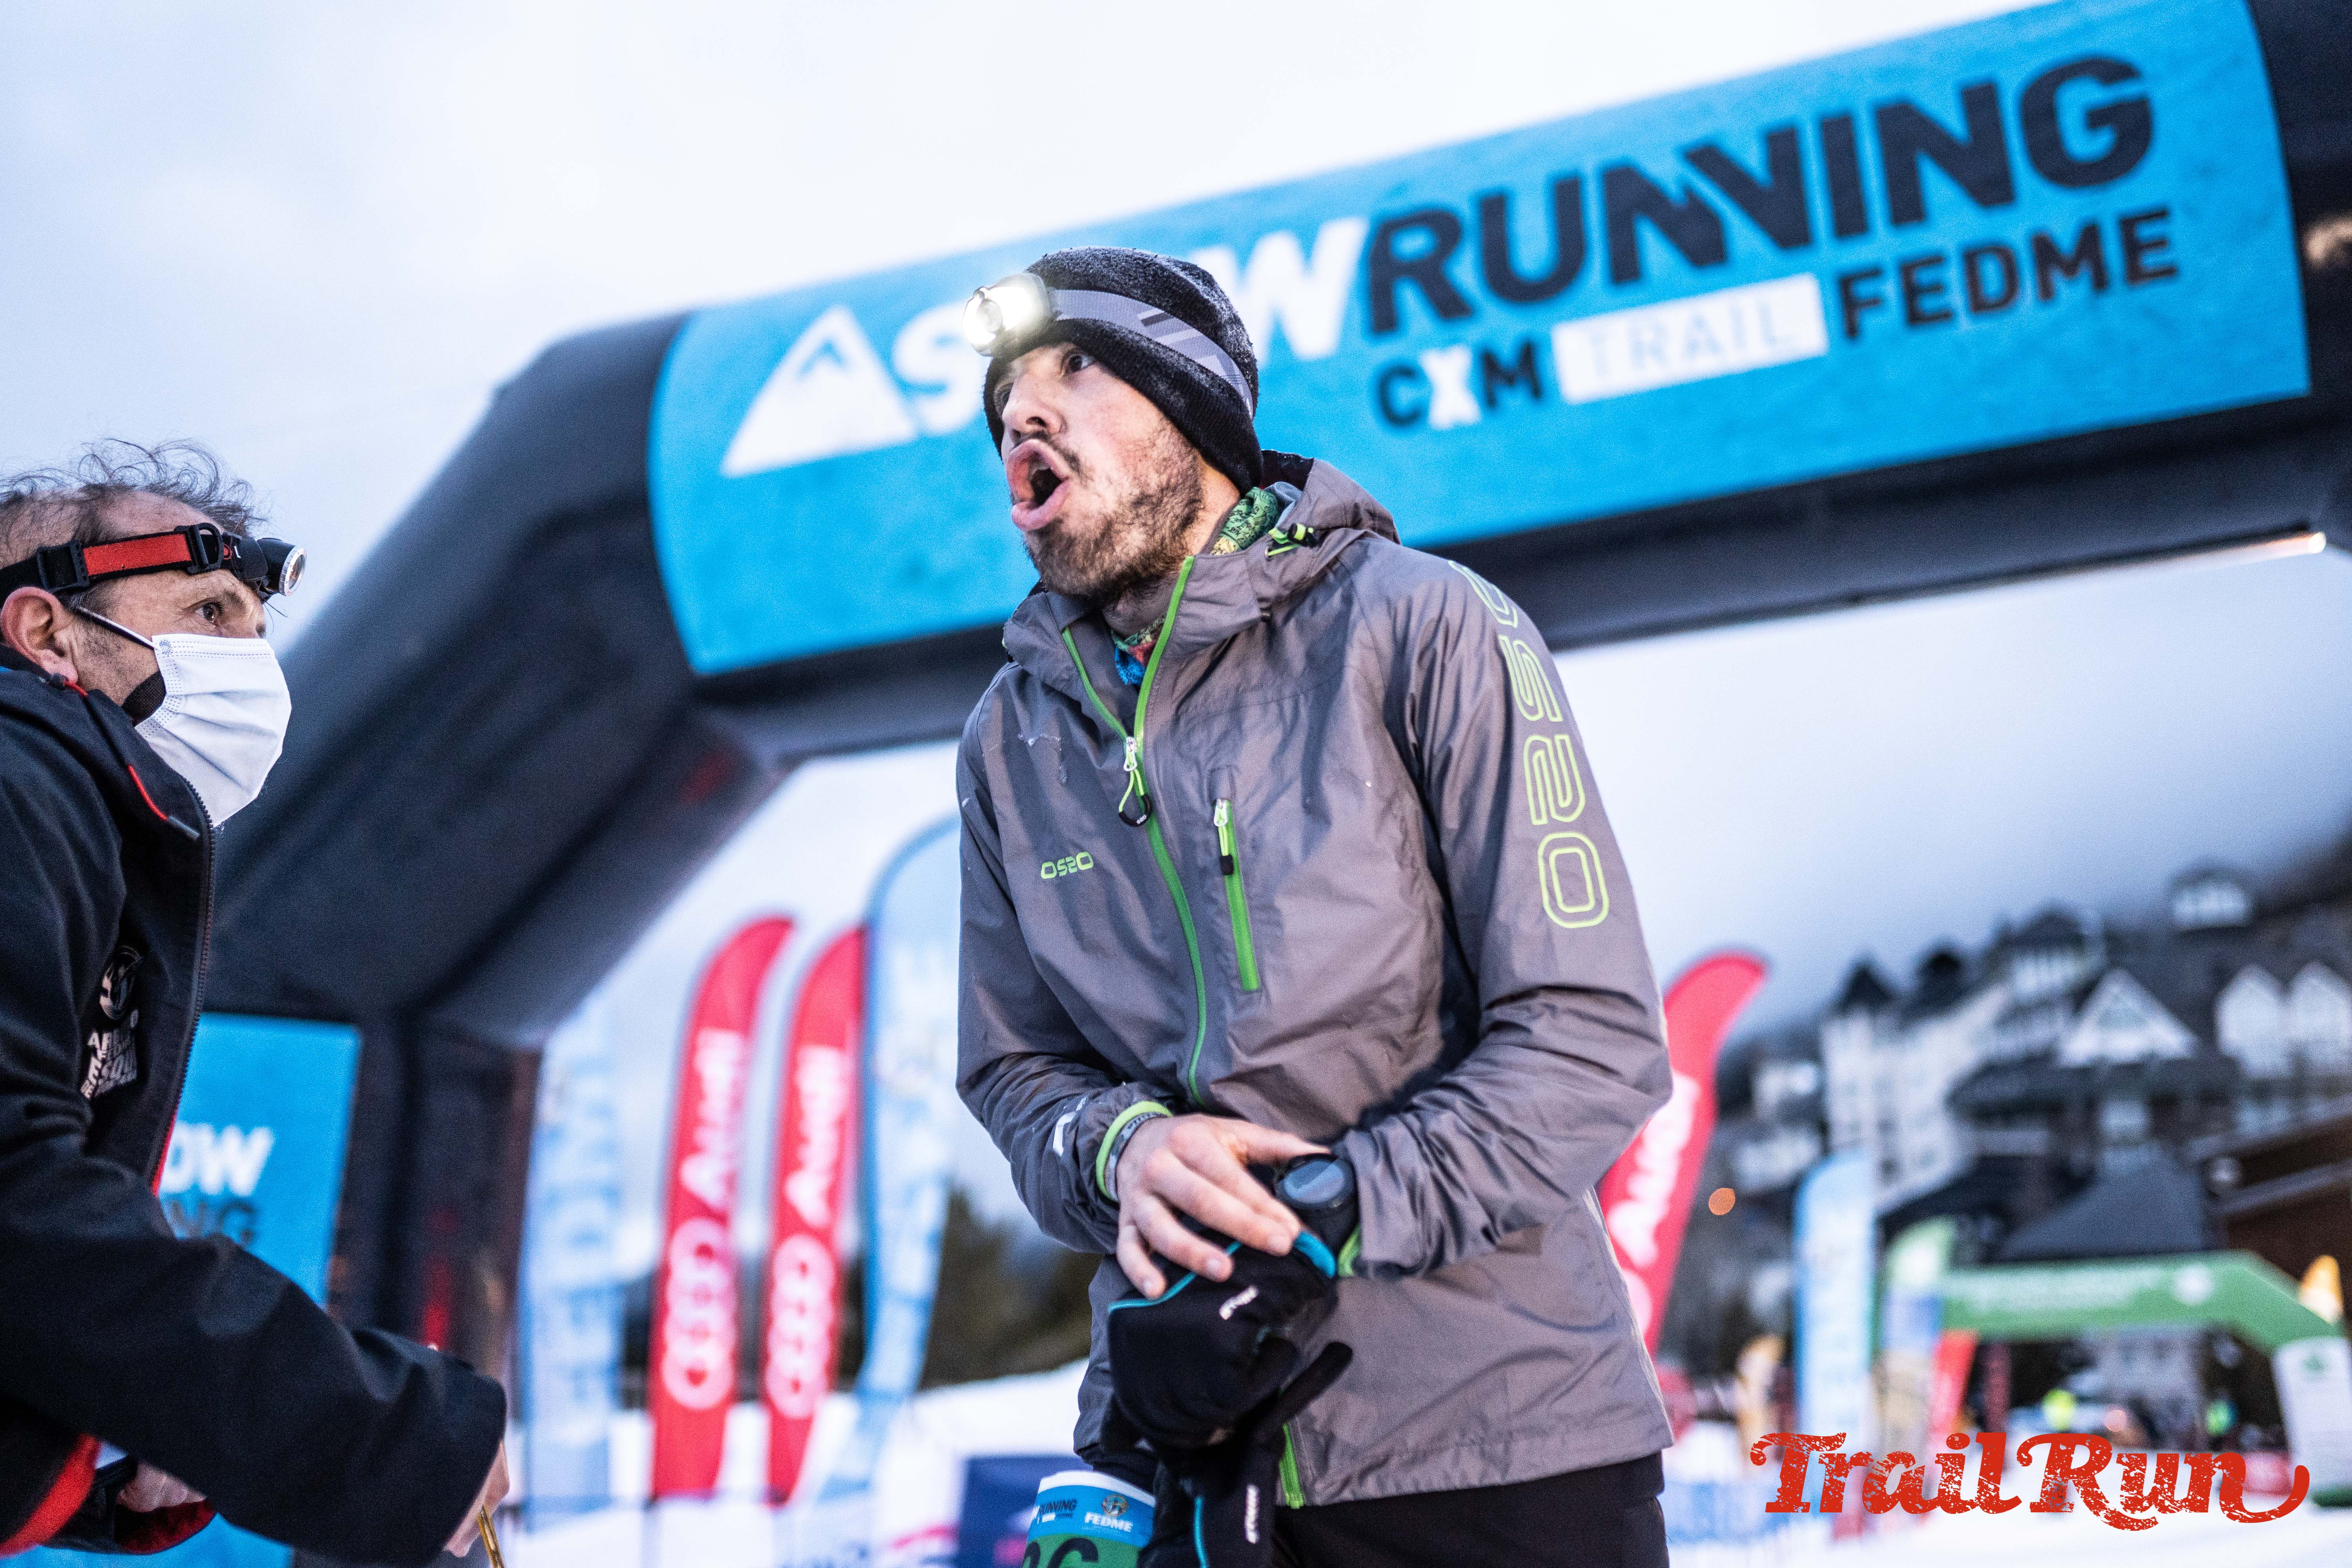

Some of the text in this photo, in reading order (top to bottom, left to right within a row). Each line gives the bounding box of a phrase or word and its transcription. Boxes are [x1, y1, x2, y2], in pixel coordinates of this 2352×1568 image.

[1582, 295, 1796, 383] TRAIL
[1838, 206, 2179, 342] FEDME
[1084, 1511, 1133, 1533] FEDME
